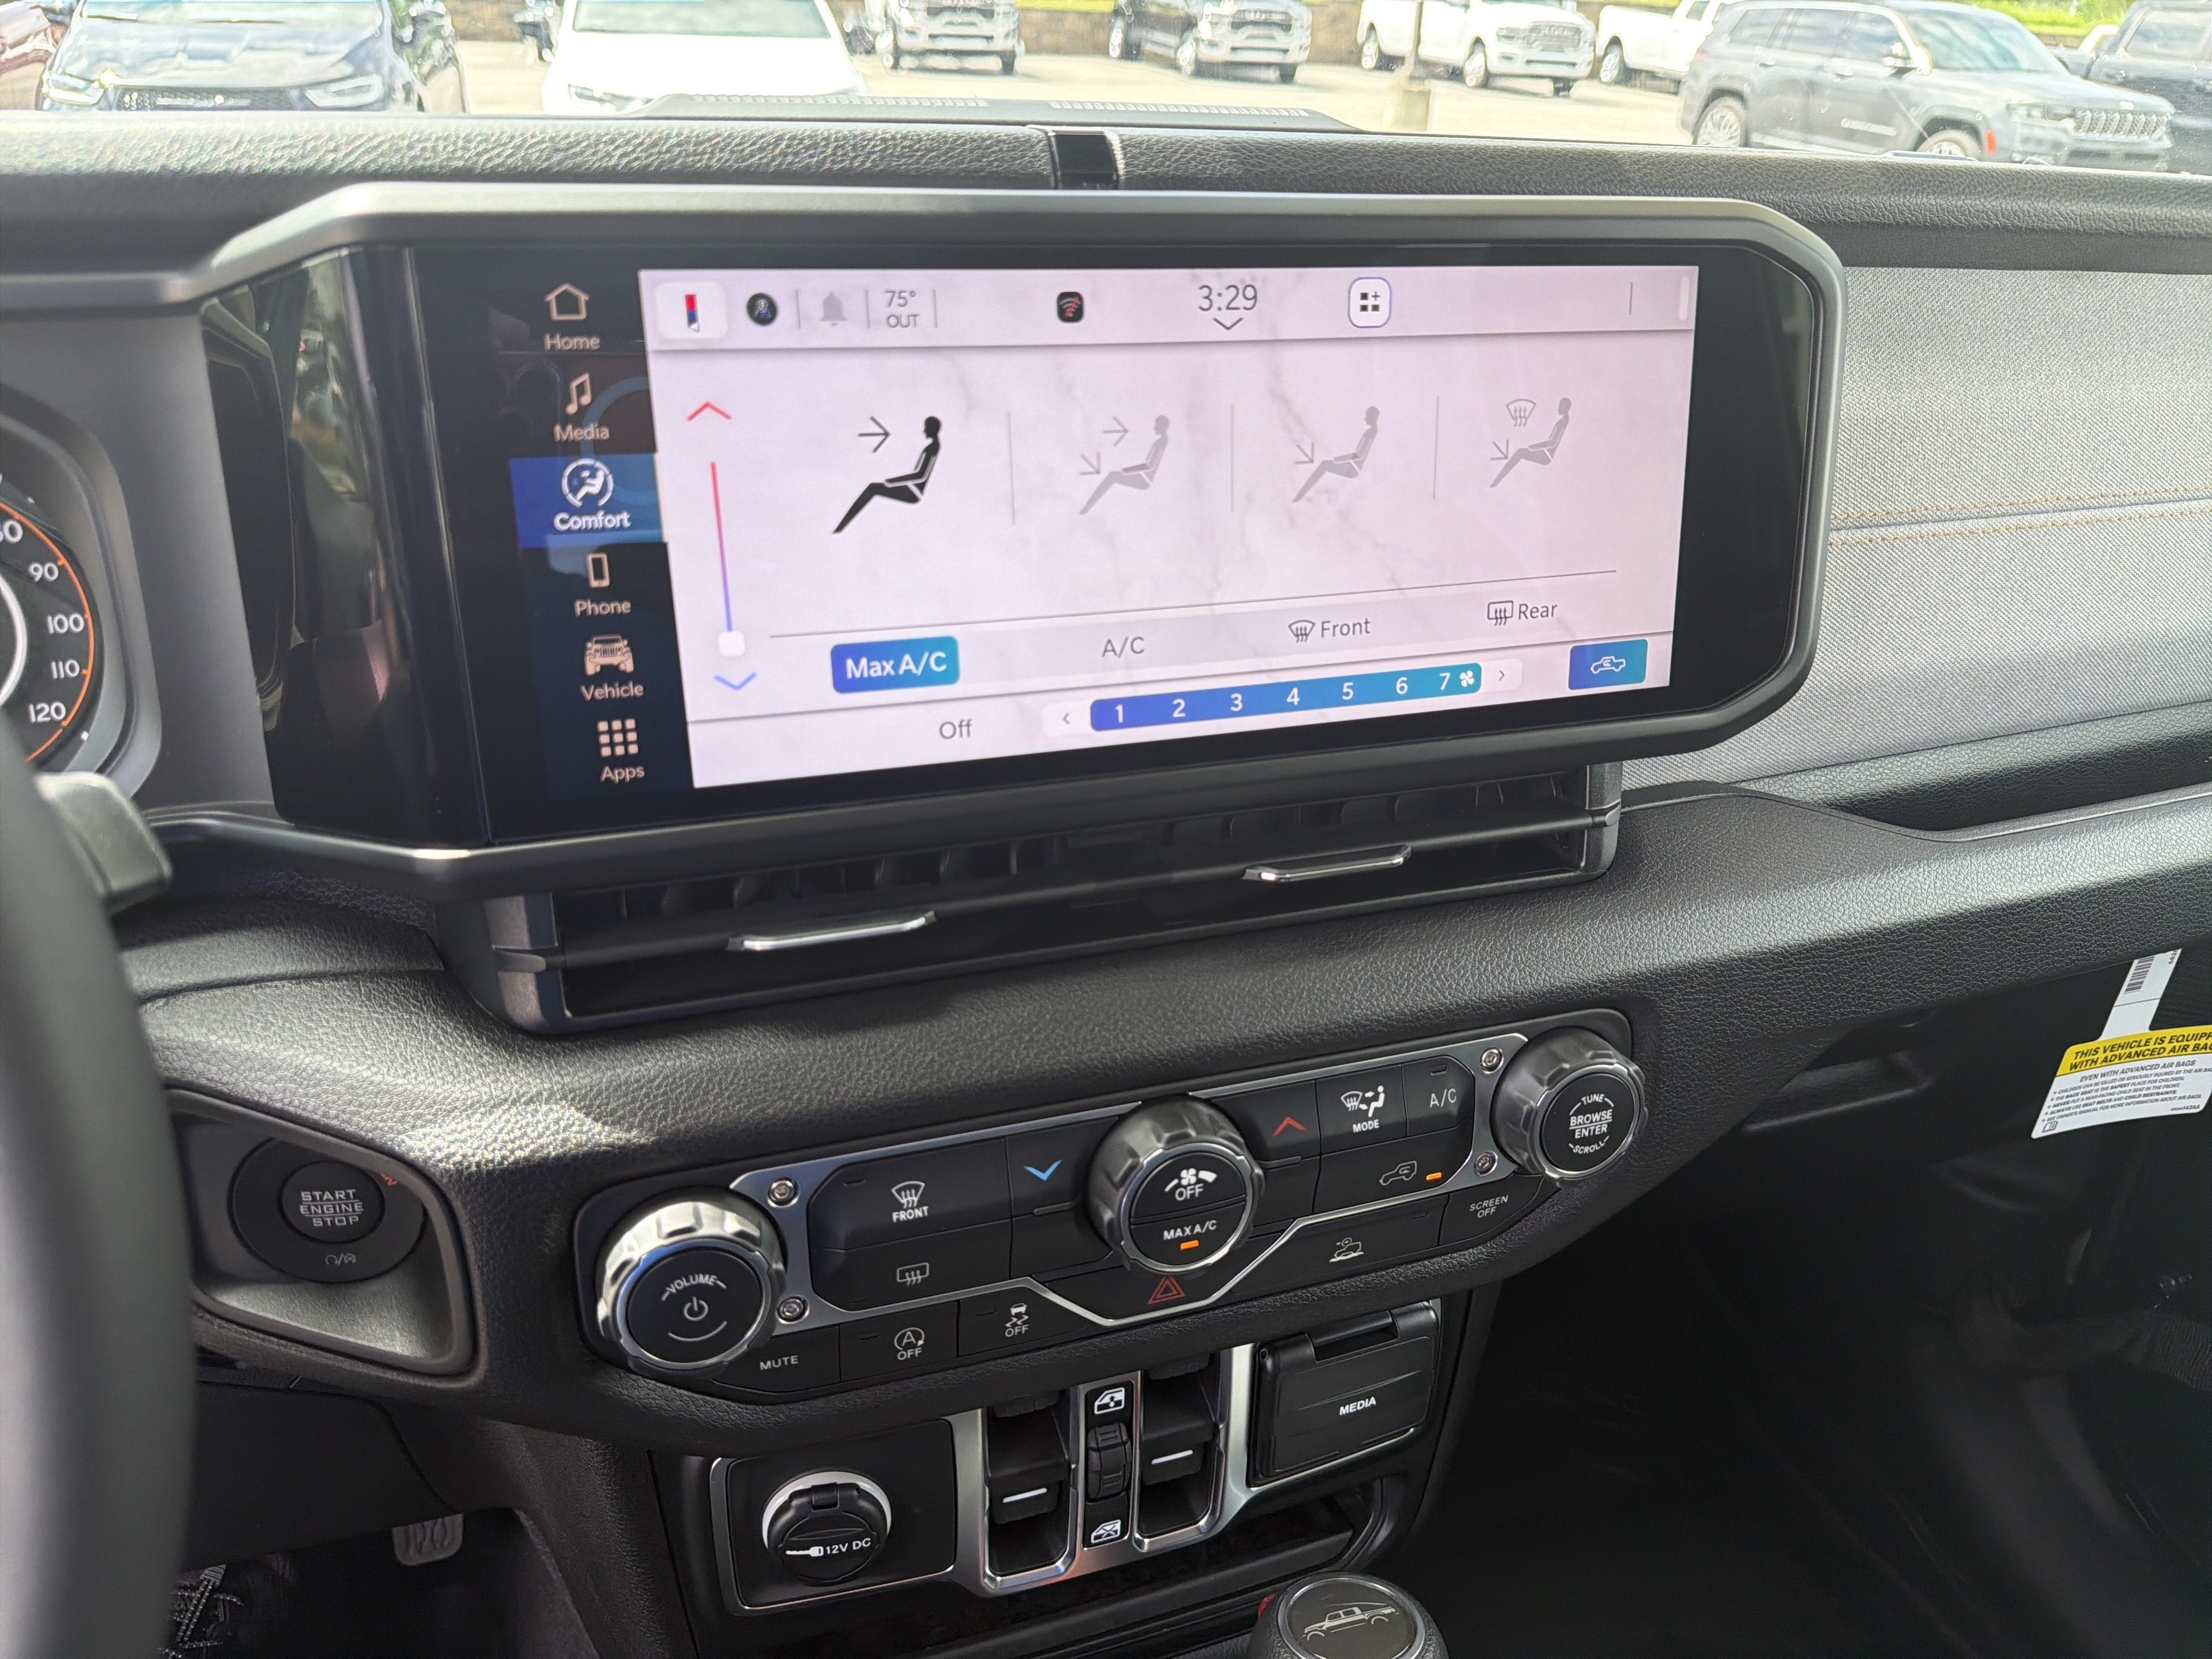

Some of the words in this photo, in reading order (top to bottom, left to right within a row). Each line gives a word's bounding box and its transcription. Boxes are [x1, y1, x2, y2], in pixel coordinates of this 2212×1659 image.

[885, 291, 916, 308] 75°
[1198, 284, 1257, 312] 3:29
[887, 315, 919, 328] OUT
[544, 334, 600, 352] Home
[554, 424, 610, 442] Media
[554, 511, 631, 531] Comfort
[0, 521, 23, 544] 0
[29, 562, 59, 582] 90
[575, 600, 631, 617] Phone
[1518, 603, 1558, 620] Rear
[47, 614, 84, 634] 100
[1320, 618, 1371, 638] Front
[1102, 636, 1145, 658] A/C
[51, 660, 80, 679] 110
[846, 657, 894, 679] Max
[899, 652, 947, 675] A/C
[580, 682, 644, 701] Vehicle
[1115, 705, 1124, 723] 1
[1172, 699, 1186, 718] 2
[1231, 693, 1243, 711] 3
[1286, 688, 1299, 706] 4
[1342, 682, 1353, 700] 5
[1396, 677, 1408, 695] 6
[1440, 673, 1450, 690] 7
[29, 702, 66, 722] 120
[939, 719, 973, 739] Off
[601, 766, 645, 783] Apps
[2074, 1047, 2100, 1060] THIS
[2103, 1038, 2152, 1053] VEHICLE
[2153, 1036, 2166, 1045] IS
[2069, 1057, 2100, 1071] WITH
[2099, 1047, 2166, 1064] ADVANCED
[2168, 1044, 2190, 1054] AIR
[2080, 1073, 2099, 1082] EVEN
[2100, 1069, 2119, 1078] WITH
[2119, 1064, 2160, 1074] ADVANCED
[1430, 1088, 1457, 1108] A/C
[1581, 1093, 1605, 1105] TUNE
[1352, 1120, 1380, 1133] MODE
[1570, 1109, 1612, 1126] BROWSE
[1575, 1124, 1607, 1138] ENTER
[1573, 1141, 1605, 1154] SCROLL
[301, 1189, 357, 1201] START
[1175, 1184, 1204, 1200] OFF
[300, 1203, 364, 1214] ENGINE
[1470, 1195, 1508, 1213] SCREEN
[1477, 1206, 1497, 1218] OFF
[313, 1216, 359, 1226] STOP
[893, 1206, 928, 1223] FRONT
[1163, 1227, 1192, 1240] MAX
[1193, 1220, 1217, 1234] A/C
[667, 1274, 718, 1295] VOLUME
[1005, 1324, 1029, 1338] OFF
[760, 1355, 799, 1370] MUTE
[897, 1347, 923, 1360] OFF
[1339, 1396, 1376, 1415] MEDIA
[826, 1543, 849, 1555] 12V
[853, 1538, 871, 1550] DC
